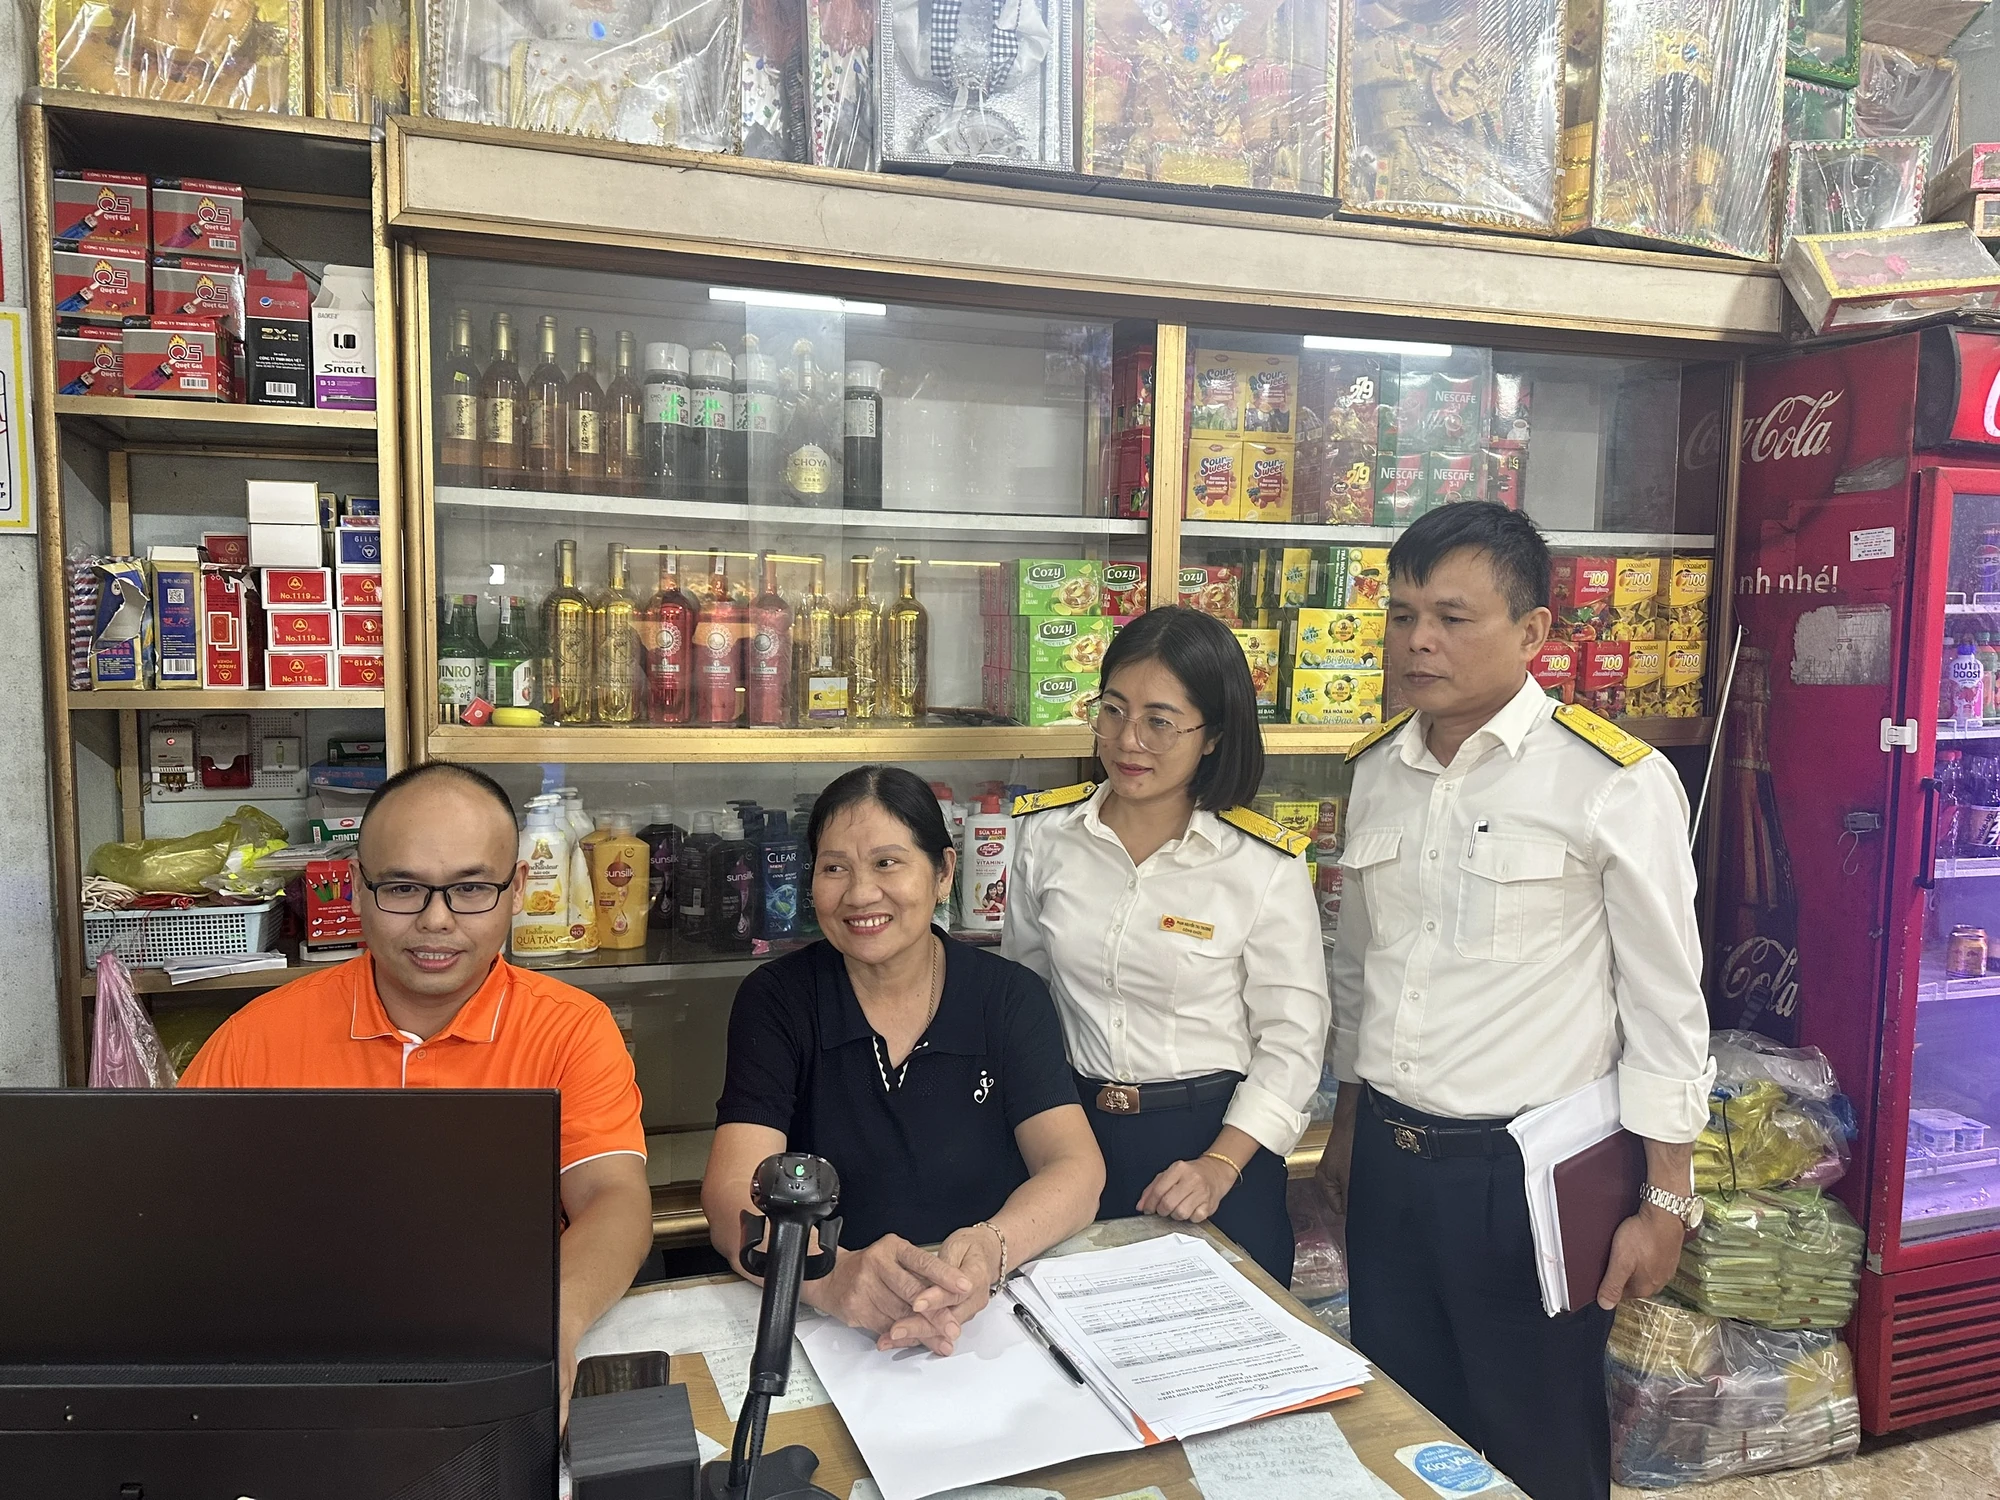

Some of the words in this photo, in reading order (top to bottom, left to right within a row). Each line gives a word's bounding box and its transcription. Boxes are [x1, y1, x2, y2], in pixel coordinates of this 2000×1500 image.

[320, 364, 366, 373] Smart
[793, 458, 827, 468] CHOYA
[1032, 566, 1061, 578] Cozy
[1107, 568, 1136, 580] Cozy
[1179, 571, 1204, 582] Cozy
[1589, 571, 1609, 586] 100
[1633, 572, 1651, 586] 100
[1688, 573, 1706, 586] 100
[1780, 566, 1838, 594] nhé!
[1043, 623, 1073, 635] Cozy
[1550, 656, 1570, 670] 100
[1602, 656, 1623, 670] 100
[1641, 654, 1658, 667] 100
[1682, 654, 1699, 668] 100
[438, 665, 471, 677] JINRO
[1953, 670, 1981, 679] boost
[1043, 680, 1073, 691] Cozy
[651, 855, 679, 864] sunsilk
[767, 852, 796, 863] CLEAR
[605, 869, 634, 878] sunsilk
[727, 871, 754, 882] sunsilk
[516, 935, 537, 945] QUÀ
[538, 935, 563, 945] TẶNG
